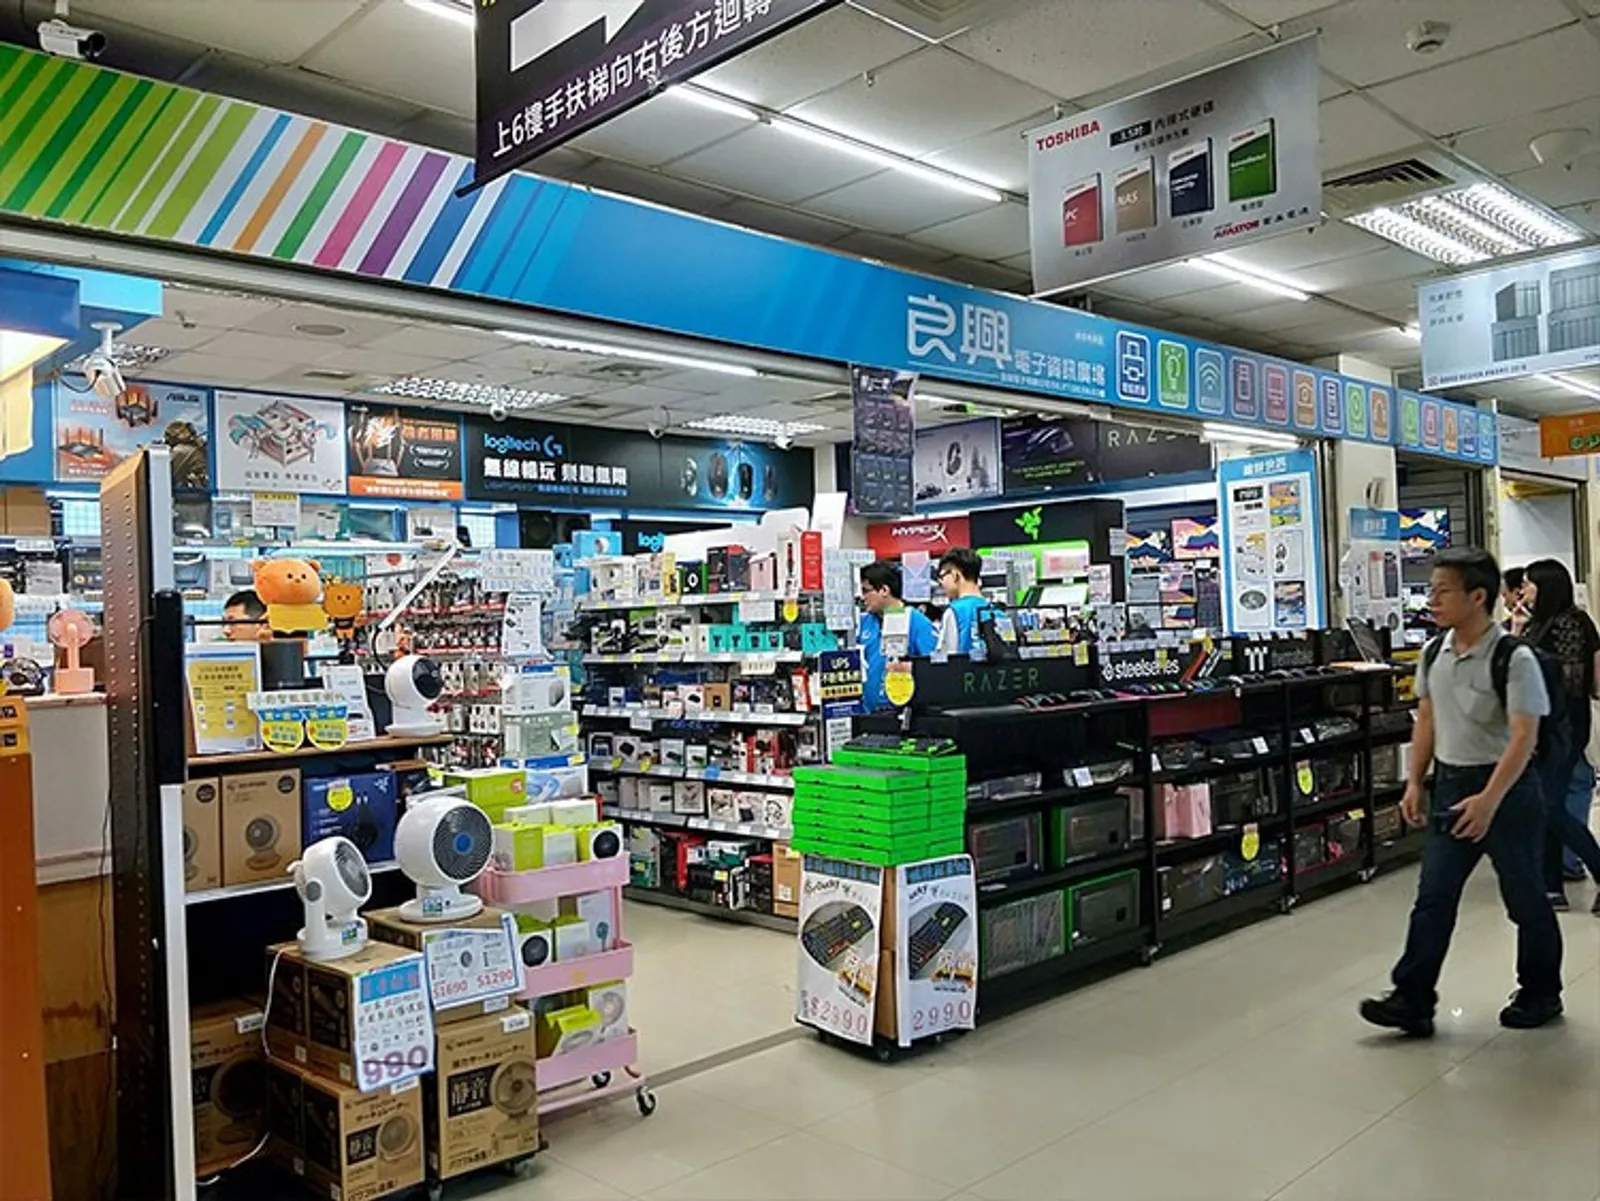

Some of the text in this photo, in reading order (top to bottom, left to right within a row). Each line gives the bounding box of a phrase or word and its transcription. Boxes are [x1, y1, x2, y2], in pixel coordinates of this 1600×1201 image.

[1036, 120, 1101, 151] TOSHIBA
[907, 294, 1013, 371] 良興
[484, 433, 541, 453] logitech
[1107, 426, 1178, 448] RAZ
[831, 657, 851, 669] UPS
[963, 667, 1039, 694] RAZER
[912, 999, 972, 1032] 2990
[362, 1045, 428, 1085] 990
